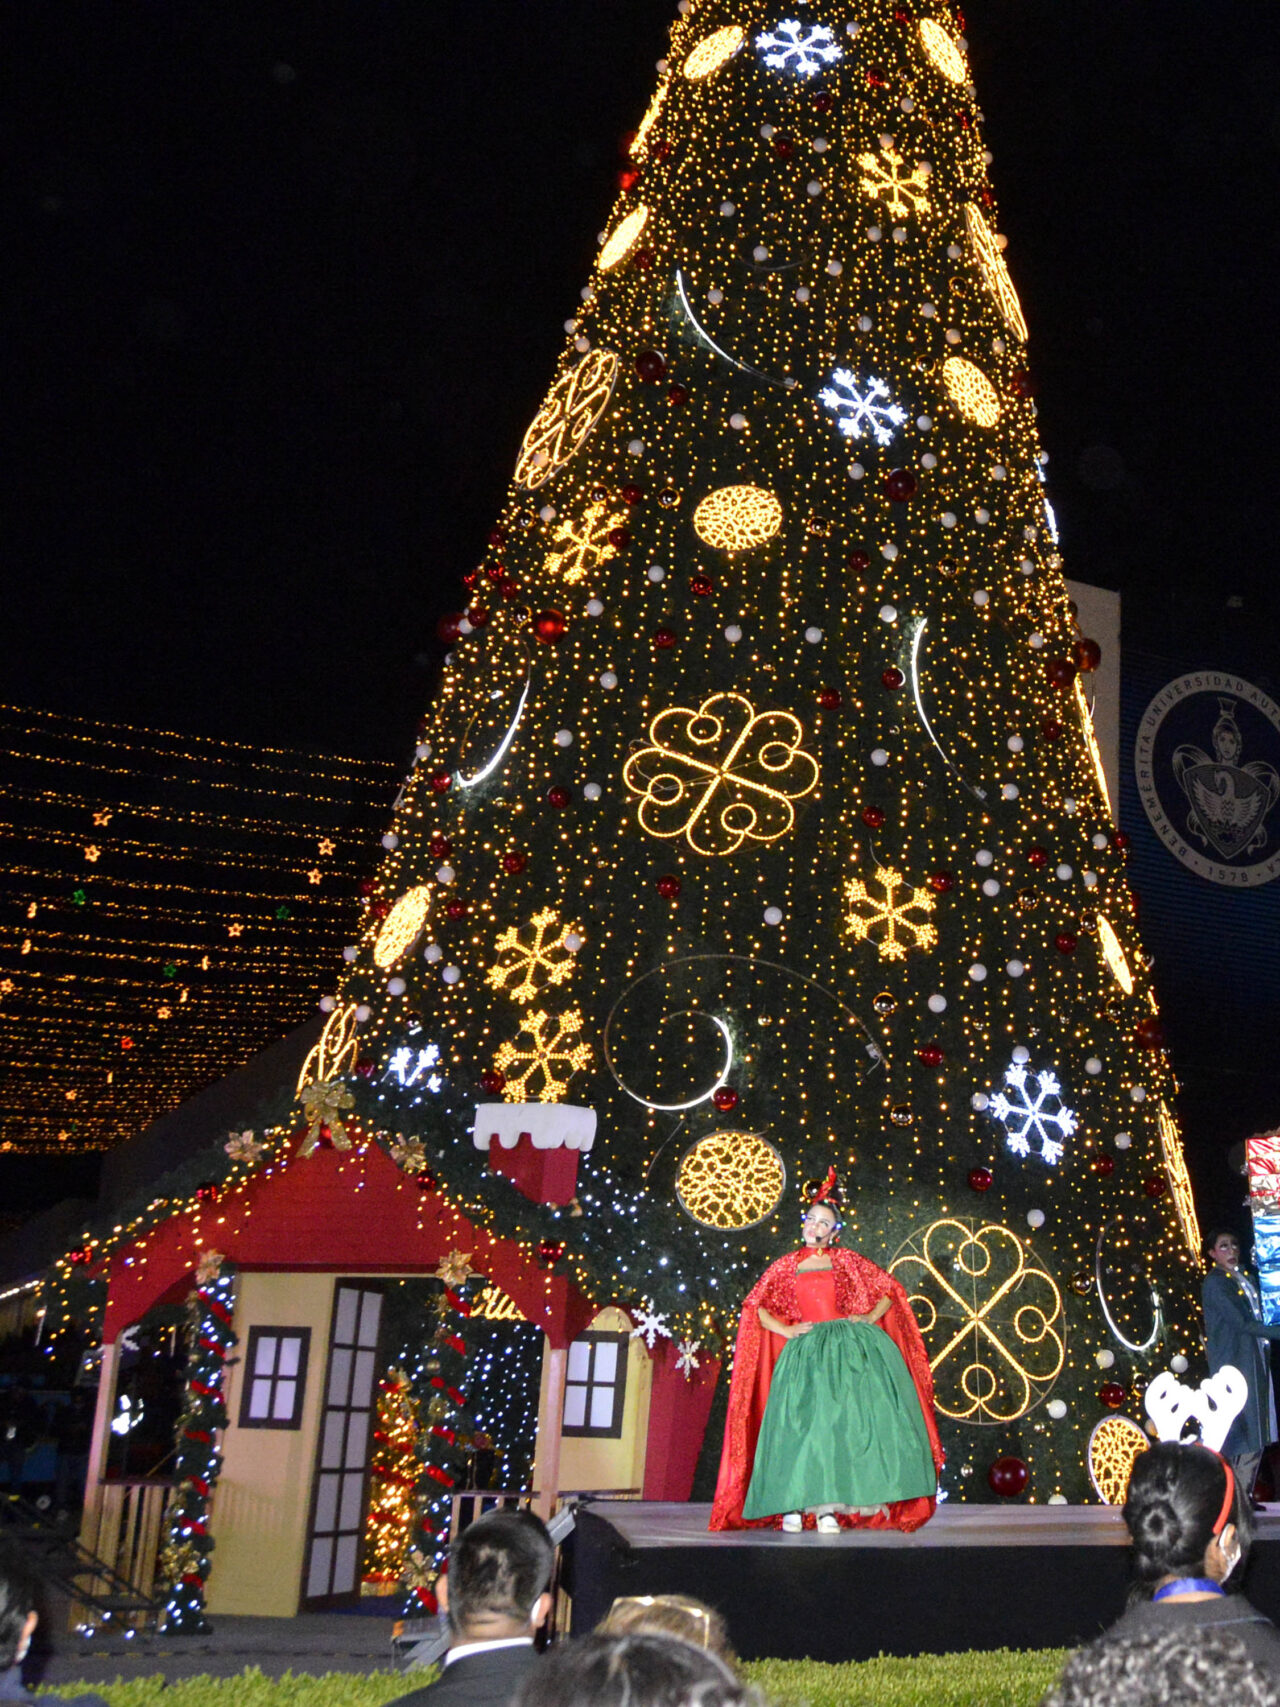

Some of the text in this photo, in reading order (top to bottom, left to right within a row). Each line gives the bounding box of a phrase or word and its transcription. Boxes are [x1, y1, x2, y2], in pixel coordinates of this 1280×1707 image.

[1147, 676, 1244, 727] UNIVERSIDAD
[1139, 735, 1187, 857] BENEMÉRITA
[1208, 867, 1249, 883] 1578
